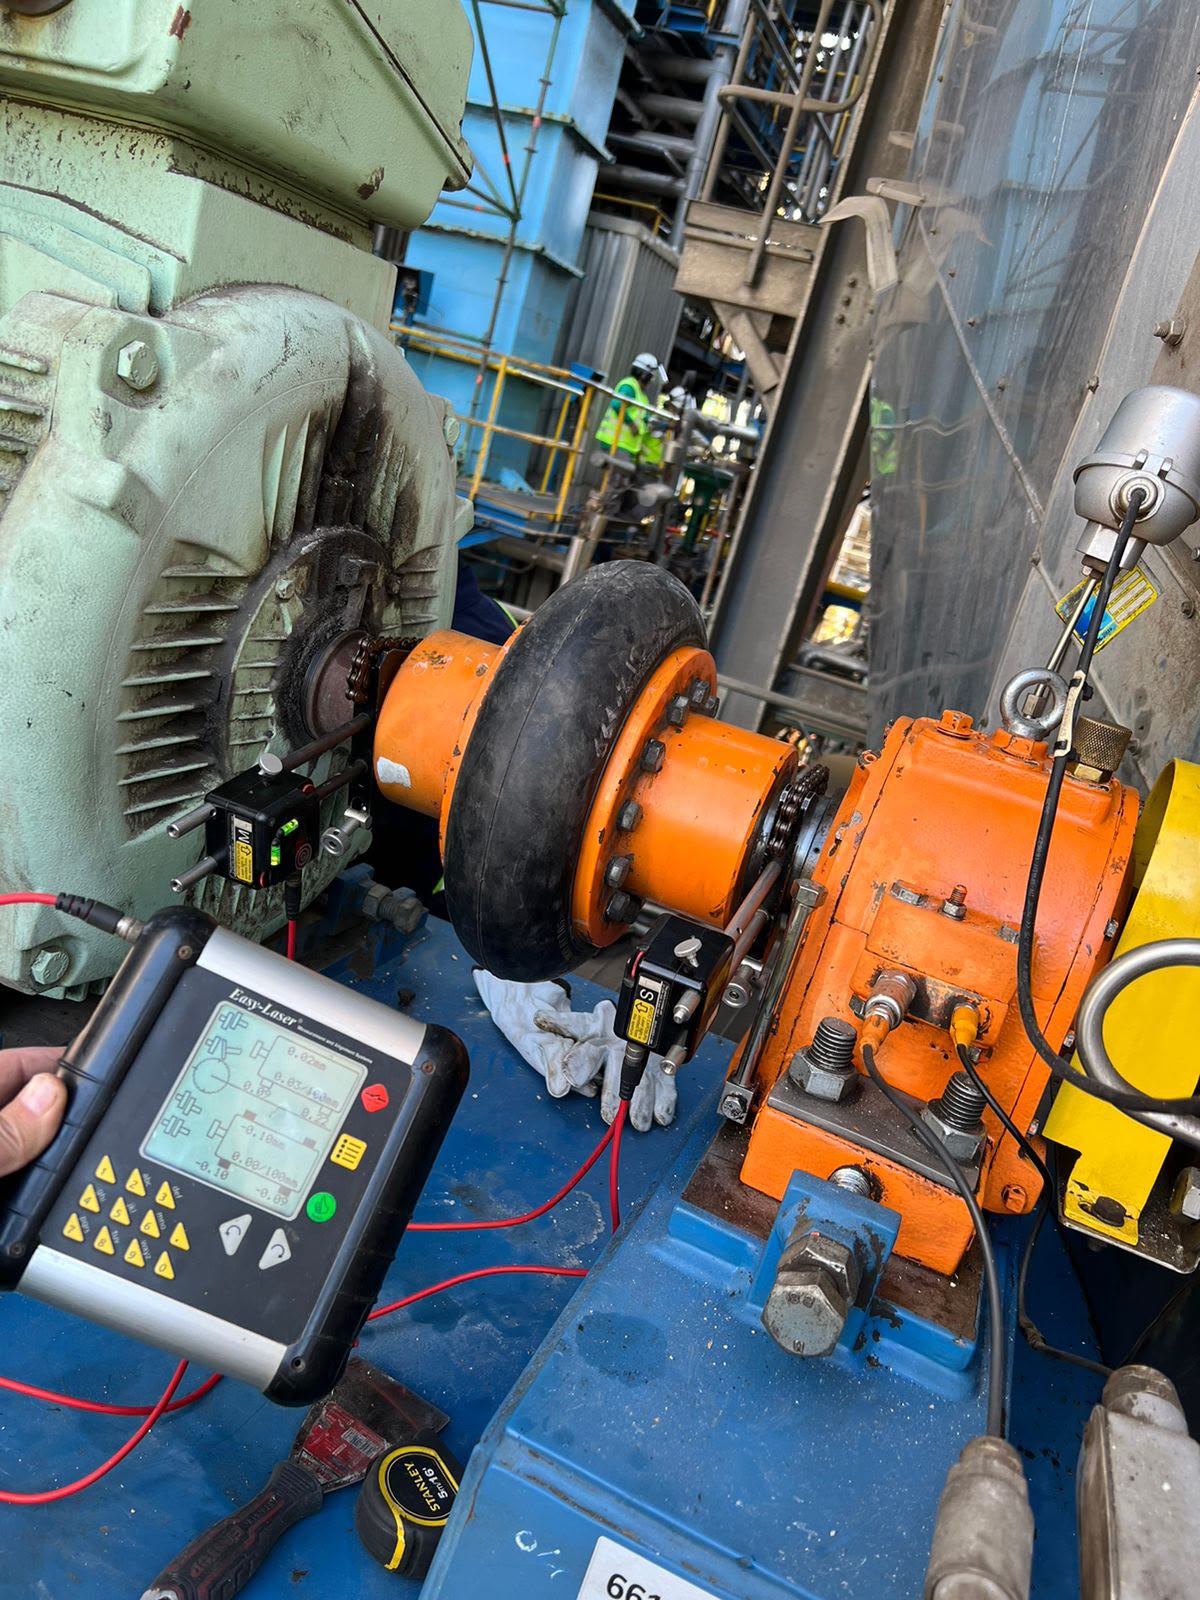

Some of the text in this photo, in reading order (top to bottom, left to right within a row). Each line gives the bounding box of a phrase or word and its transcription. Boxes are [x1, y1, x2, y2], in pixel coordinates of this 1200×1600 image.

[640, 989, 654, 1001] S
[404, 1462, 441, 1512] STANLEY
[606, 1573, 661, 1600] 66
